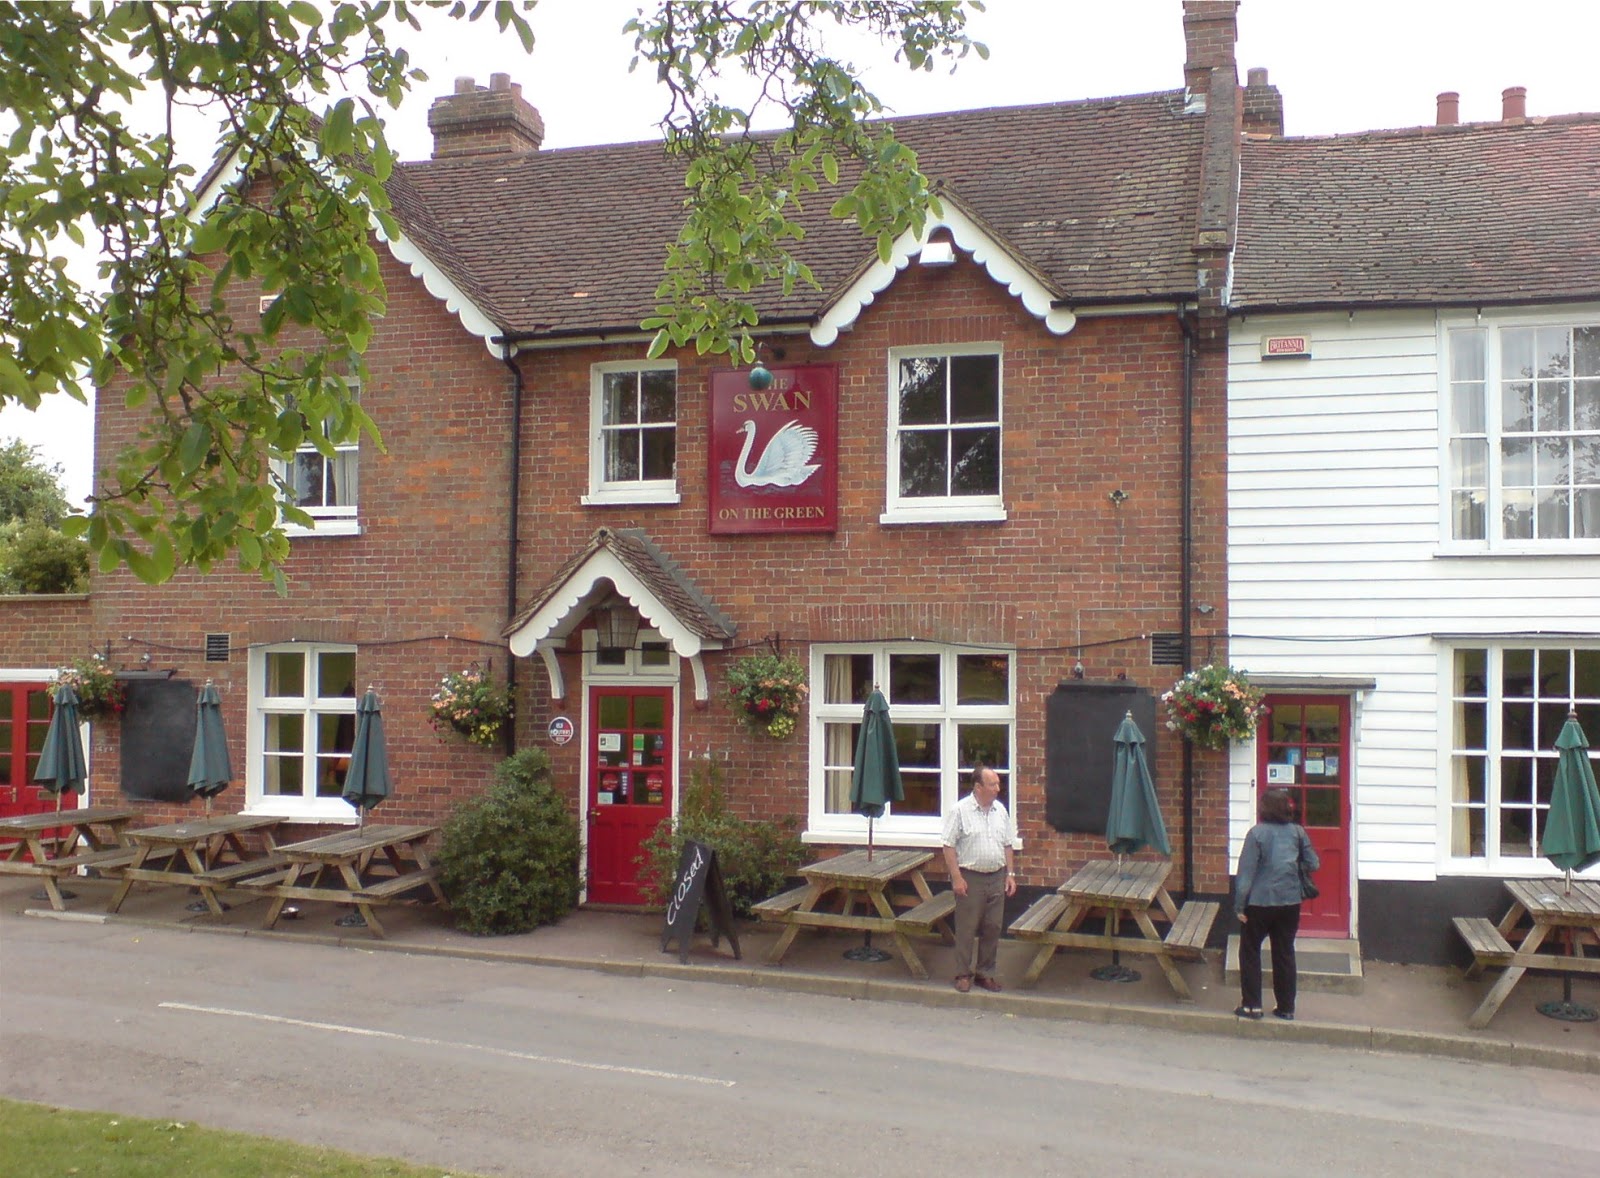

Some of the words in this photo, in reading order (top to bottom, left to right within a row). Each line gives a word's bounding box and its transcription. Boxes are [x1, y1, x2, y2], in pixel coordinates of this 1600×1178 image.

[733, 390, 811, 413] SWAN
[719, 508, 739, 520] ON
[744, 507, 772, 519] THE
[774, 506, 825, 519] GREEN
